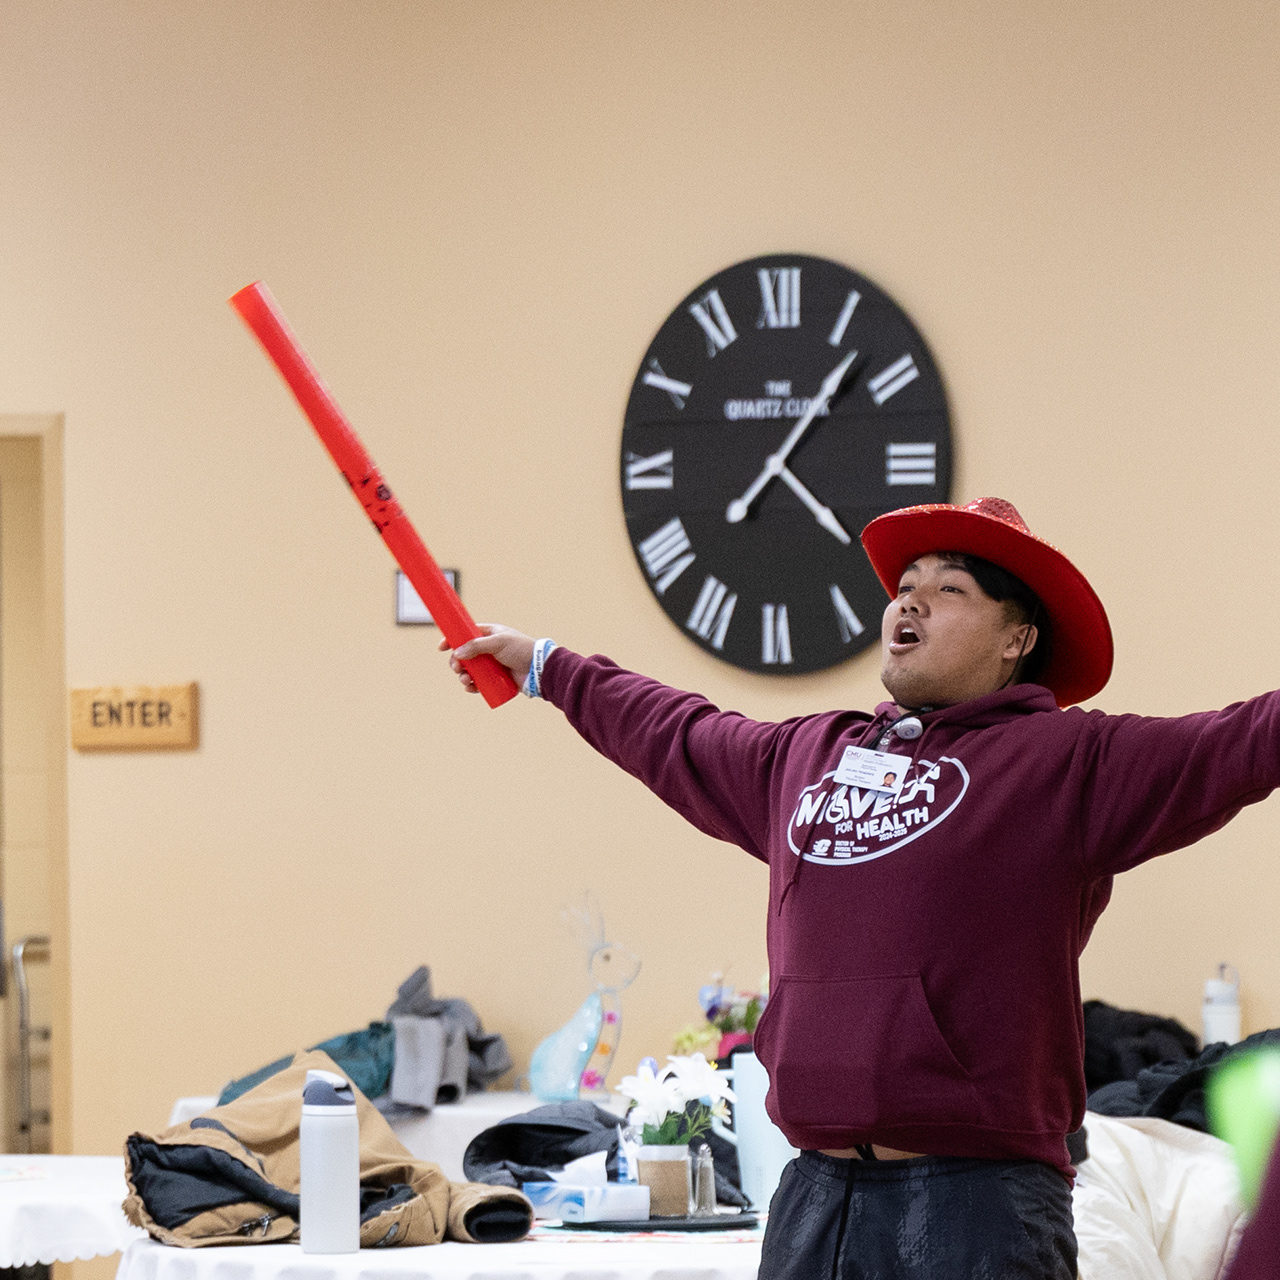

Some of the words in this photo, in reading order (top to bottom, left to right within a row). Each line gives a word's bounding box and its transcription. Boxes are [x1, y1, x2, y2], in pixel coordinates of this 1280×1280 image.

[756, 267, 802, 330] XII
[689, 288, 738, 358] XI
[866, 352, 920, 406] II
[723, 398, 782, 421] QUARTZ
[624, 447, 674, 491] IX
[886, 442, 937, 486] III
[91, 700, 173, 728] ENTER
[835, 820, 853, 836] FOR
[856, 806, 929, 840] HEALTH
